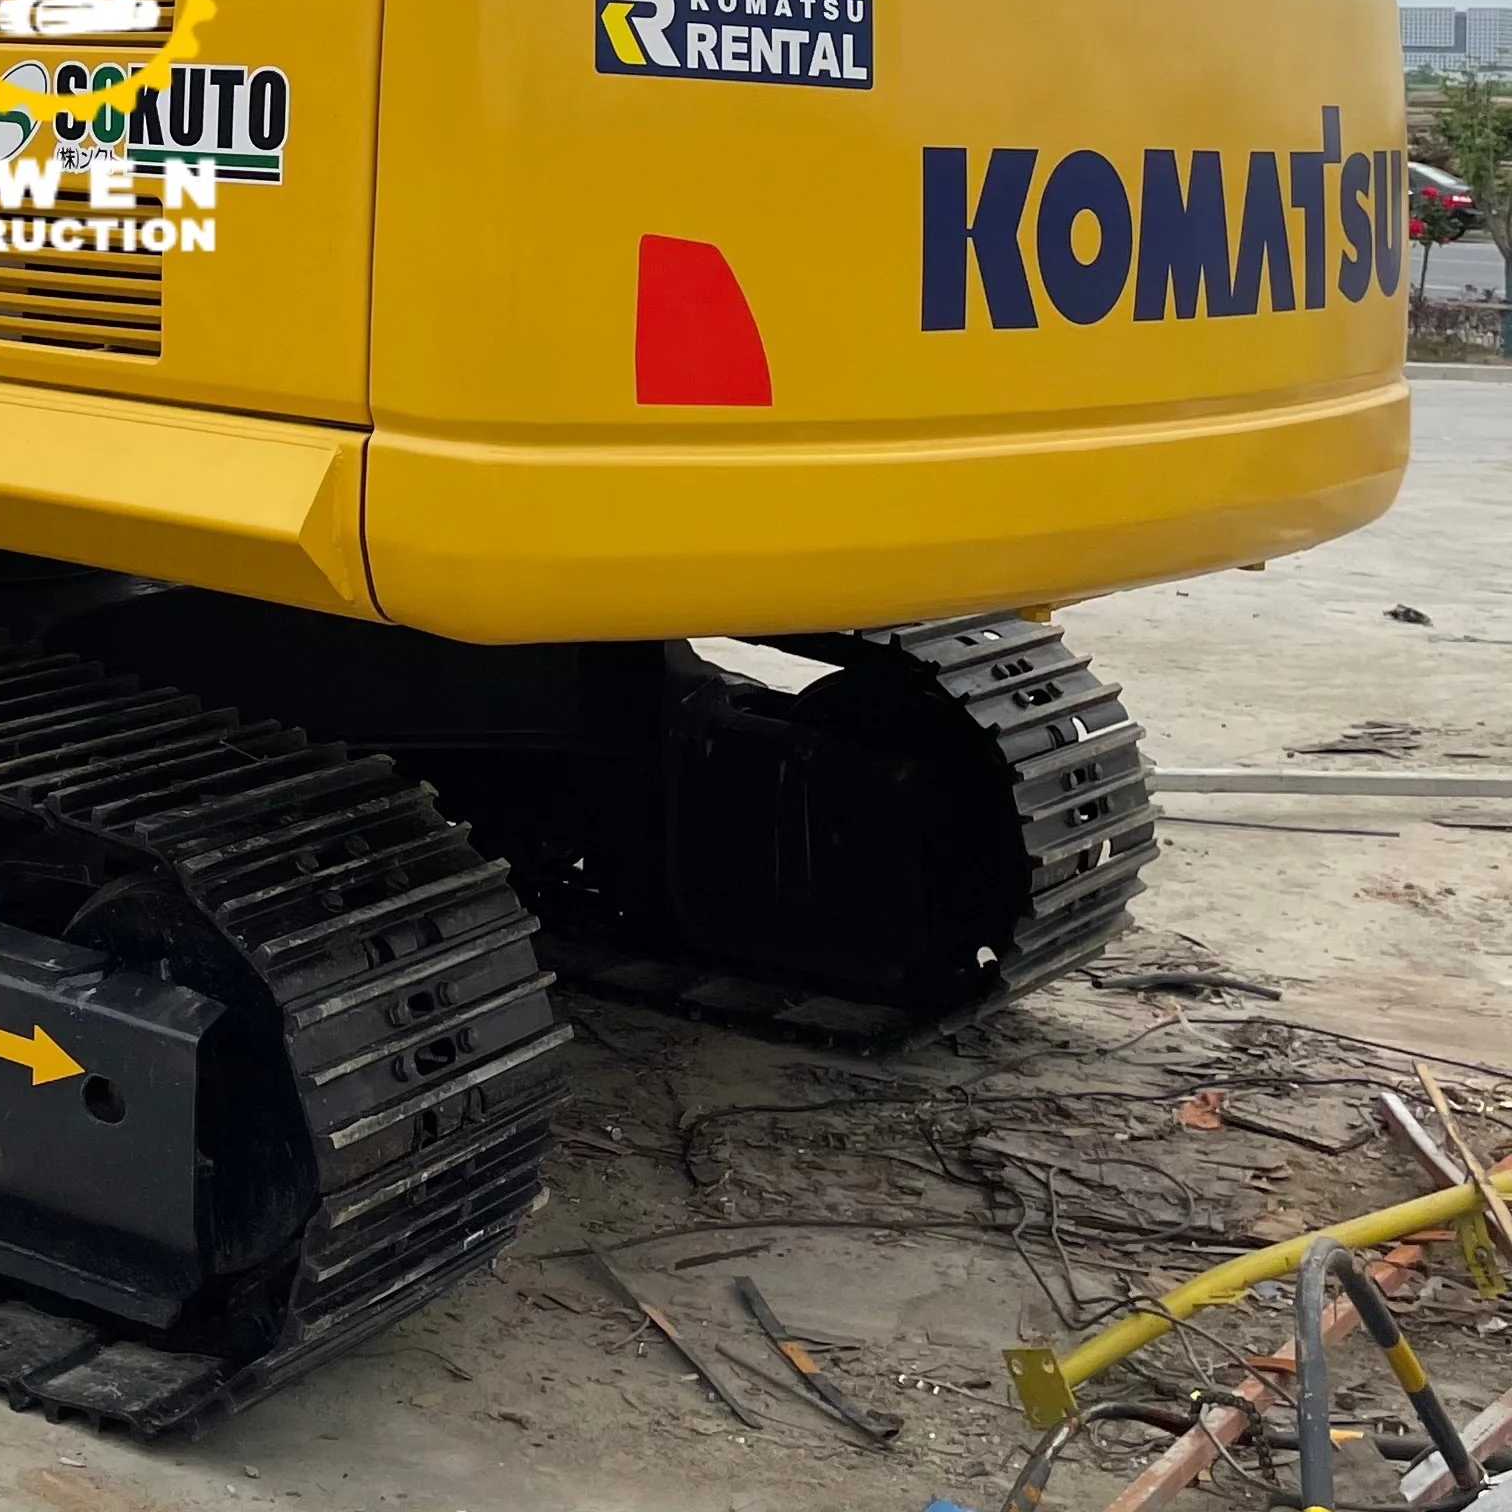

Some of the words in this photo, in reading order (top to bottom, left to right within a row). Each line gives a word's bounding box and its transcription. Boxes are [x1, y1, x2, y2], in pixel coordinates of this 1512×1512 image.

[686, 22, 868, 81] RENTAL
[55, 63, 288, 151] SOKUTO
[921, 105, 1402, 331] KOMATSU
